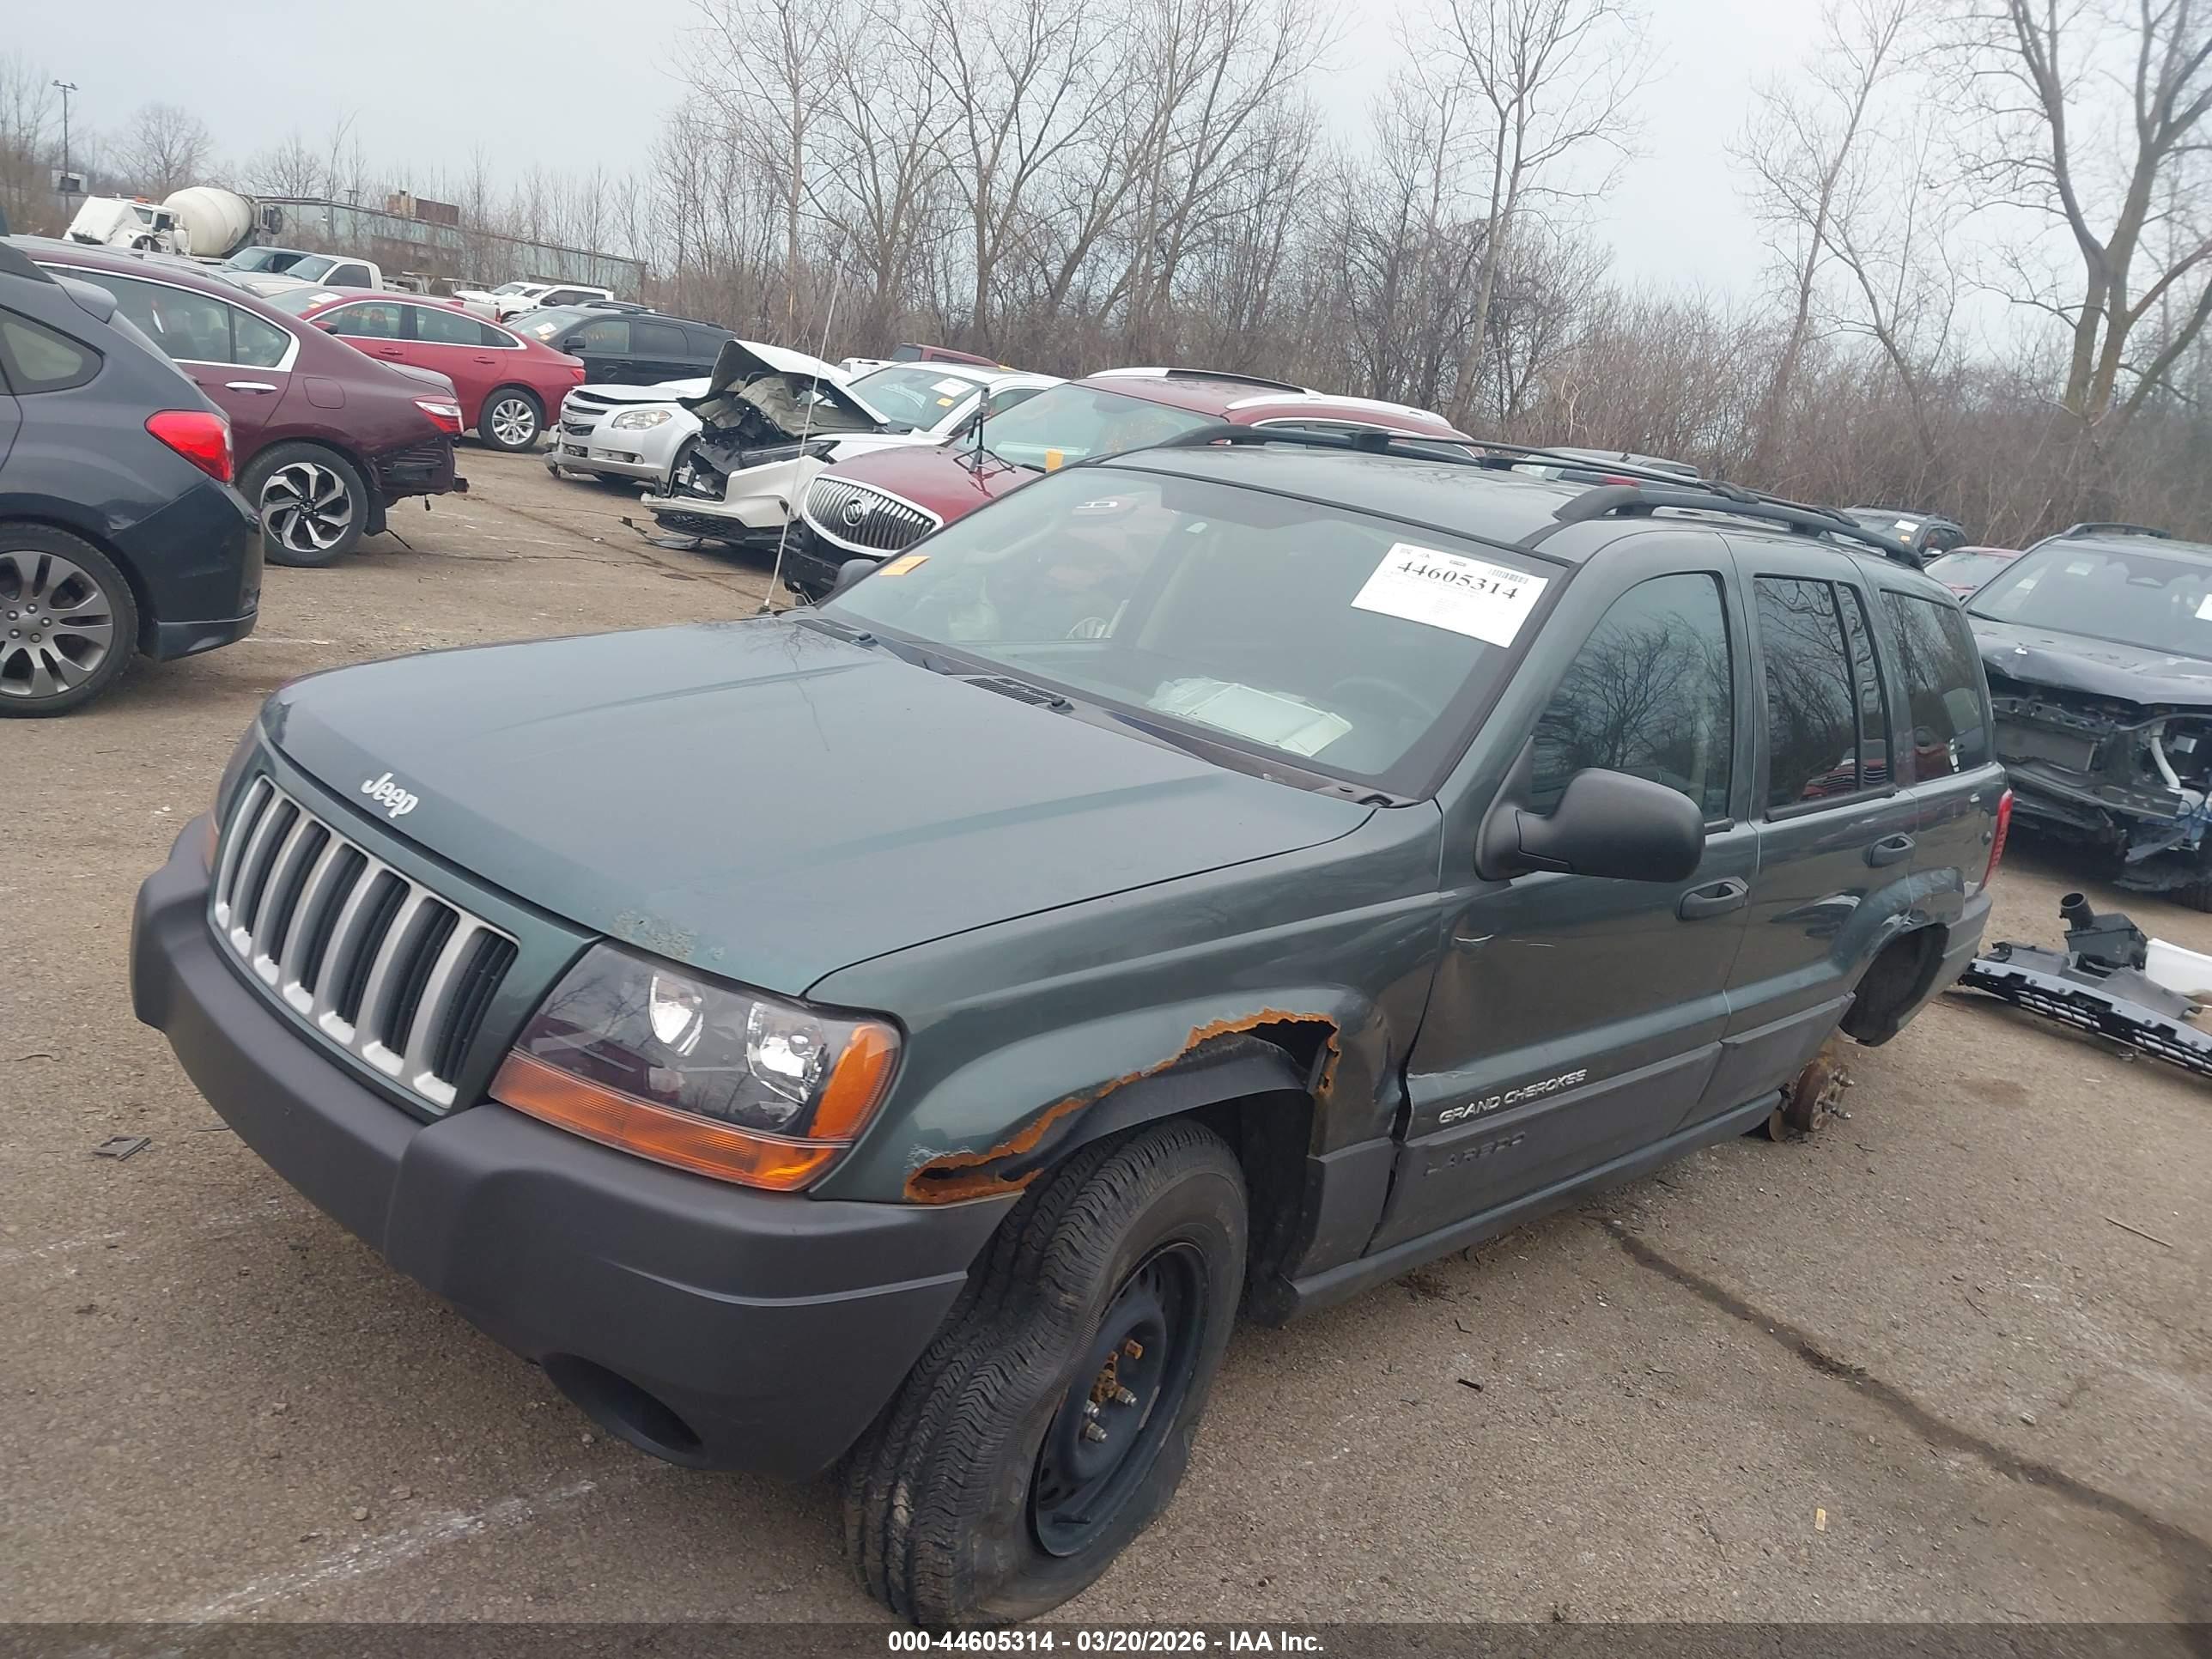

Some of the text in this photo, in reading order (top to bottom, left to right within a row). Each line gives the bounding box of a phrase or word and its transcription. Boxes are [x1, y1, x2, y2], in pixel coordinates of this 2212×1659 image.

[1397, 561, 1519, 599] 44605314
[361, 772, 419, 818] Jeep
[1439, 1068, 1588, 1124] GRAND CHEROKEE
